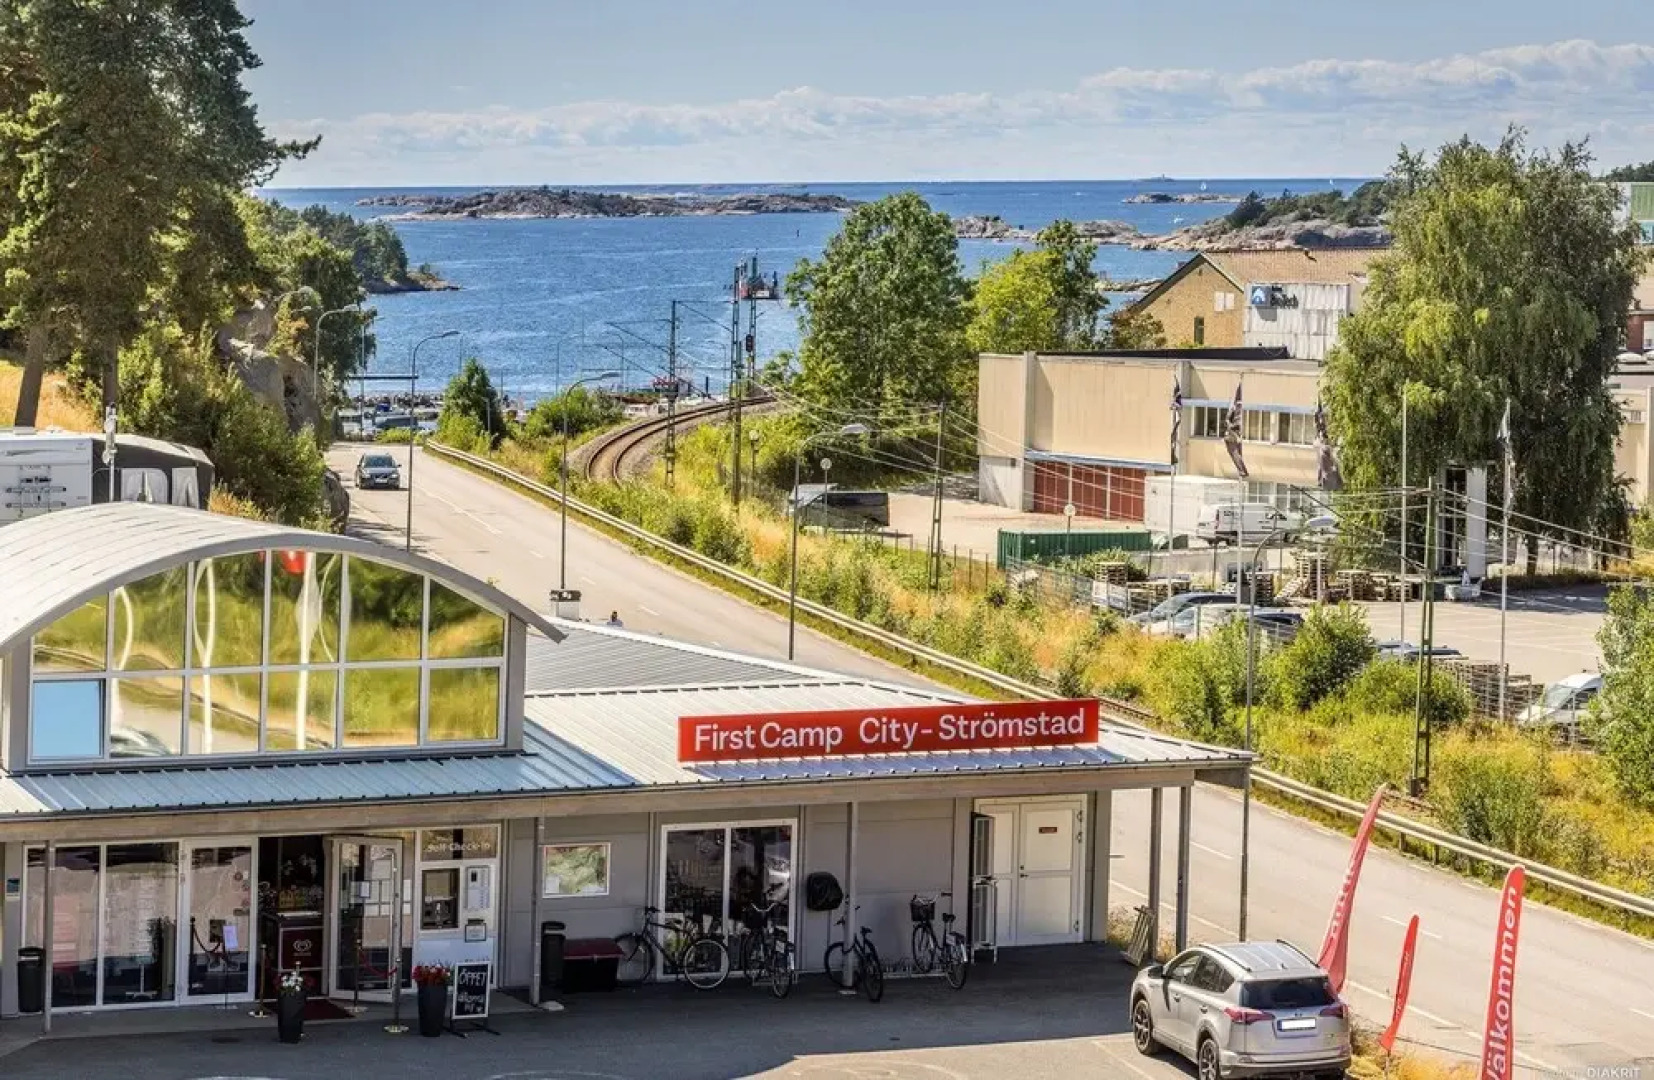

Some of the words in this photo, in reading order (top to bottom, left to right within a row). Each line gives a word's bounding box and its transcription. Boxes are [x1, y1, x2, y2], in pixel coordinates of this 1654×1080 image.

[695, 723, 756, 752] First
[760, 721, 843, 752] Camp
[939, 707, 1084, 740] Strömstad
